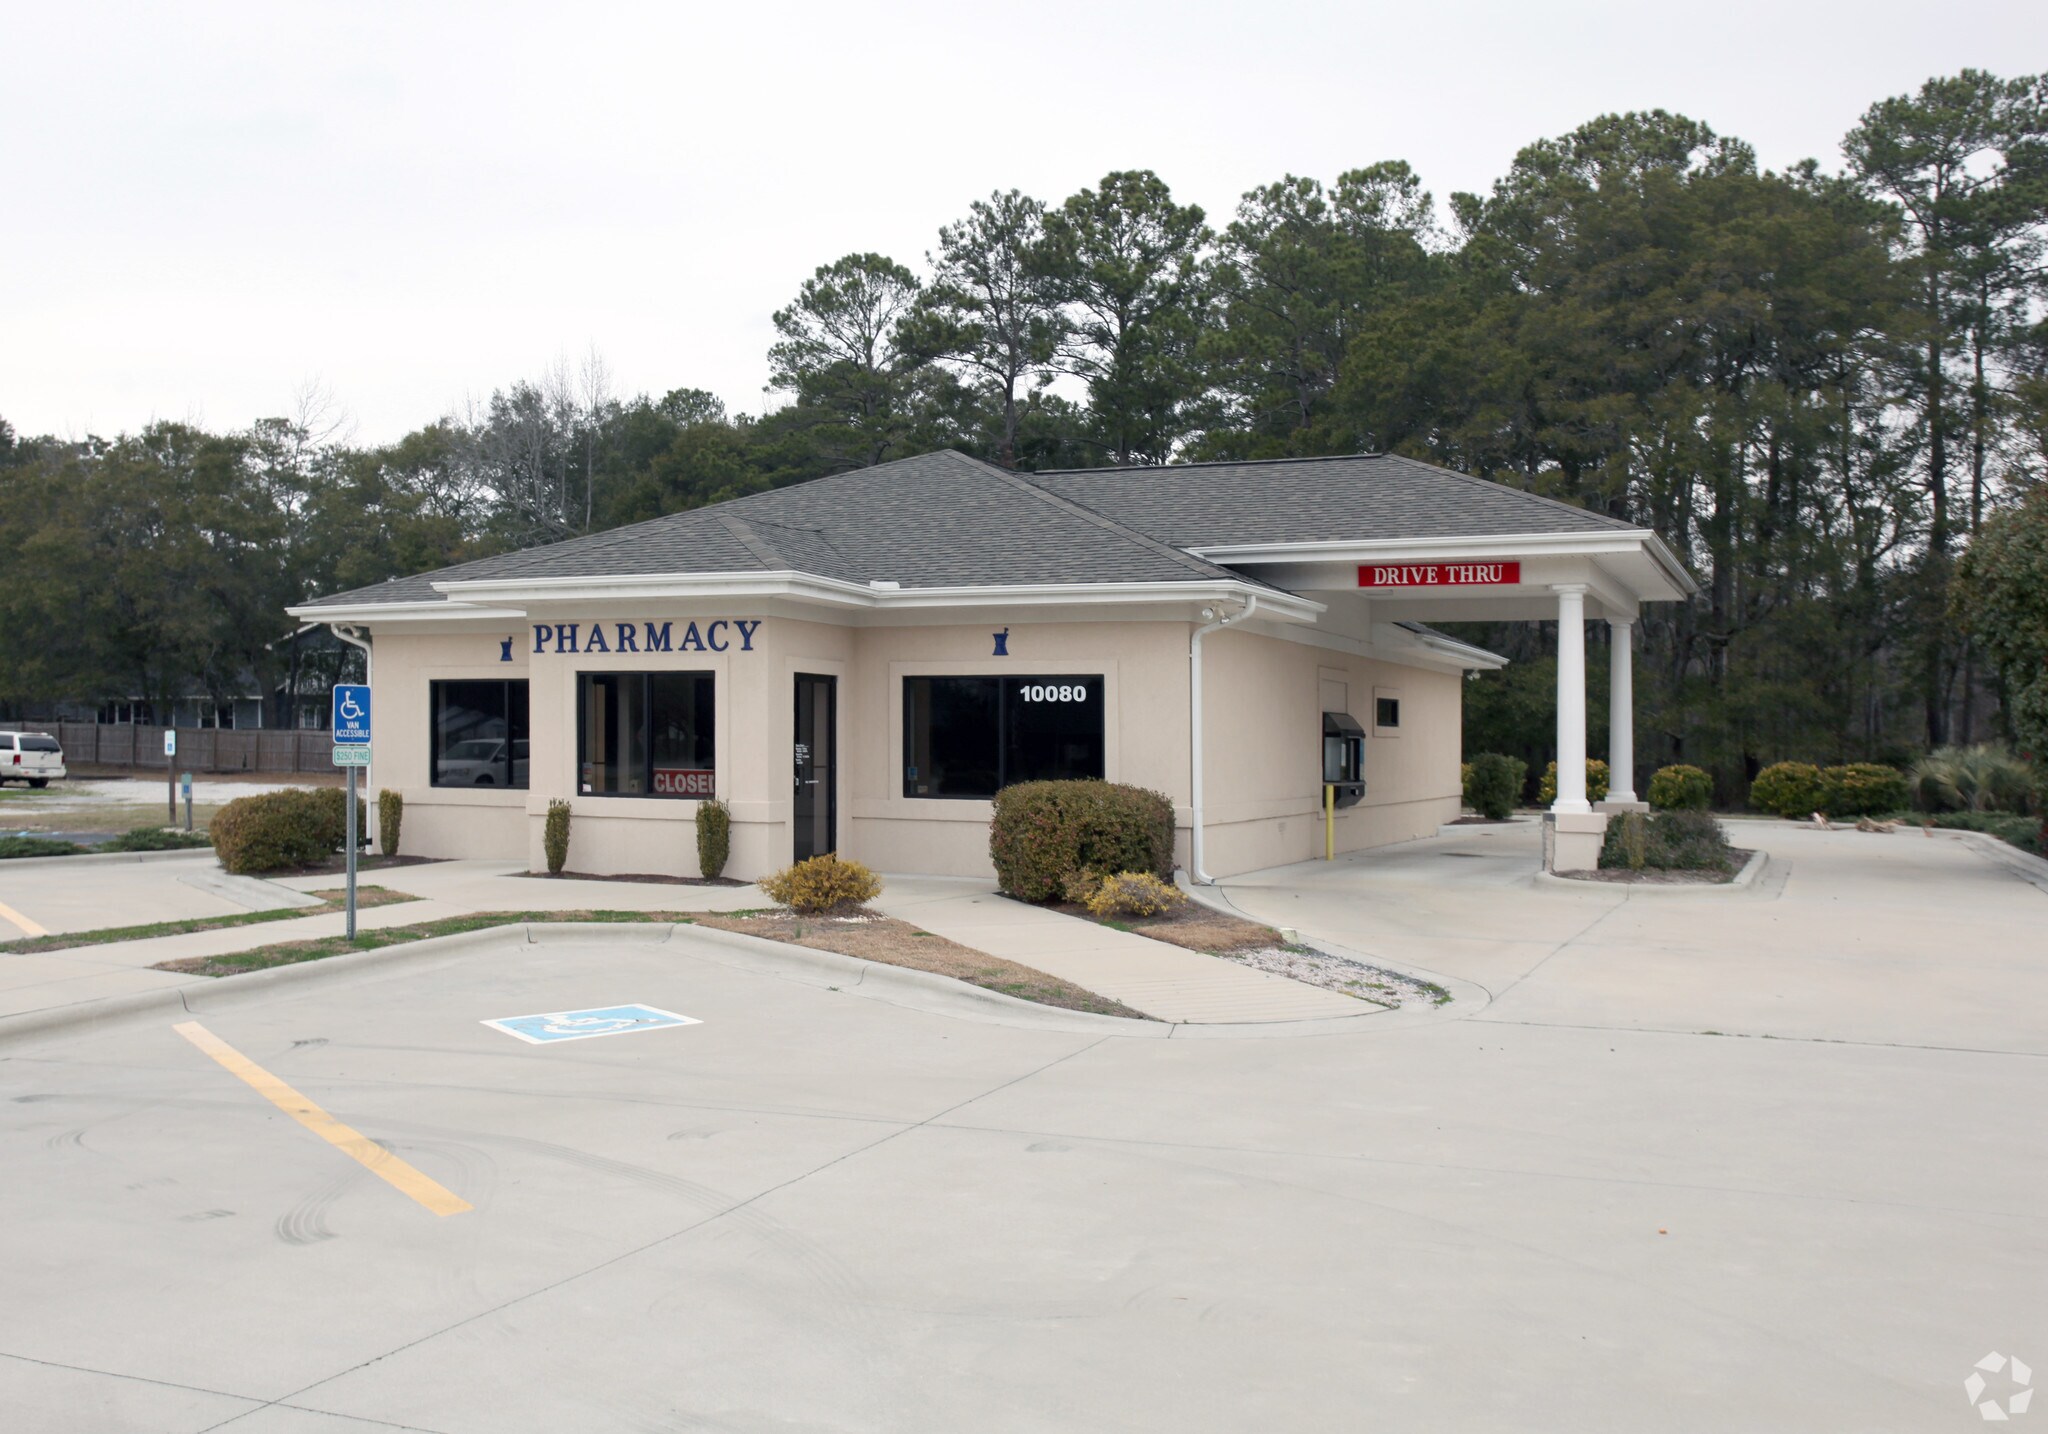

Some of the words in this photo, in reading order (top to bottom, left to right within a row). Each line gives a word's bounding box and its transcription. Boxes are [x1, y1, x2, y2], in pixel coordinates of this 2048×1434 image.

[1373, 566, 1438, 585] DRIVE
[1445, 565, 1503, 583] THRU
[532, 620, 762, 653] PHARMACY
[1020, 685, 1087, 702] 10080
[346, 721, 360, 729] VAN
[336, 729, 369, 738] ACCESSIBLE
[336, 751, 352, 760] $250
[354, 751, 368, 760] FINE
